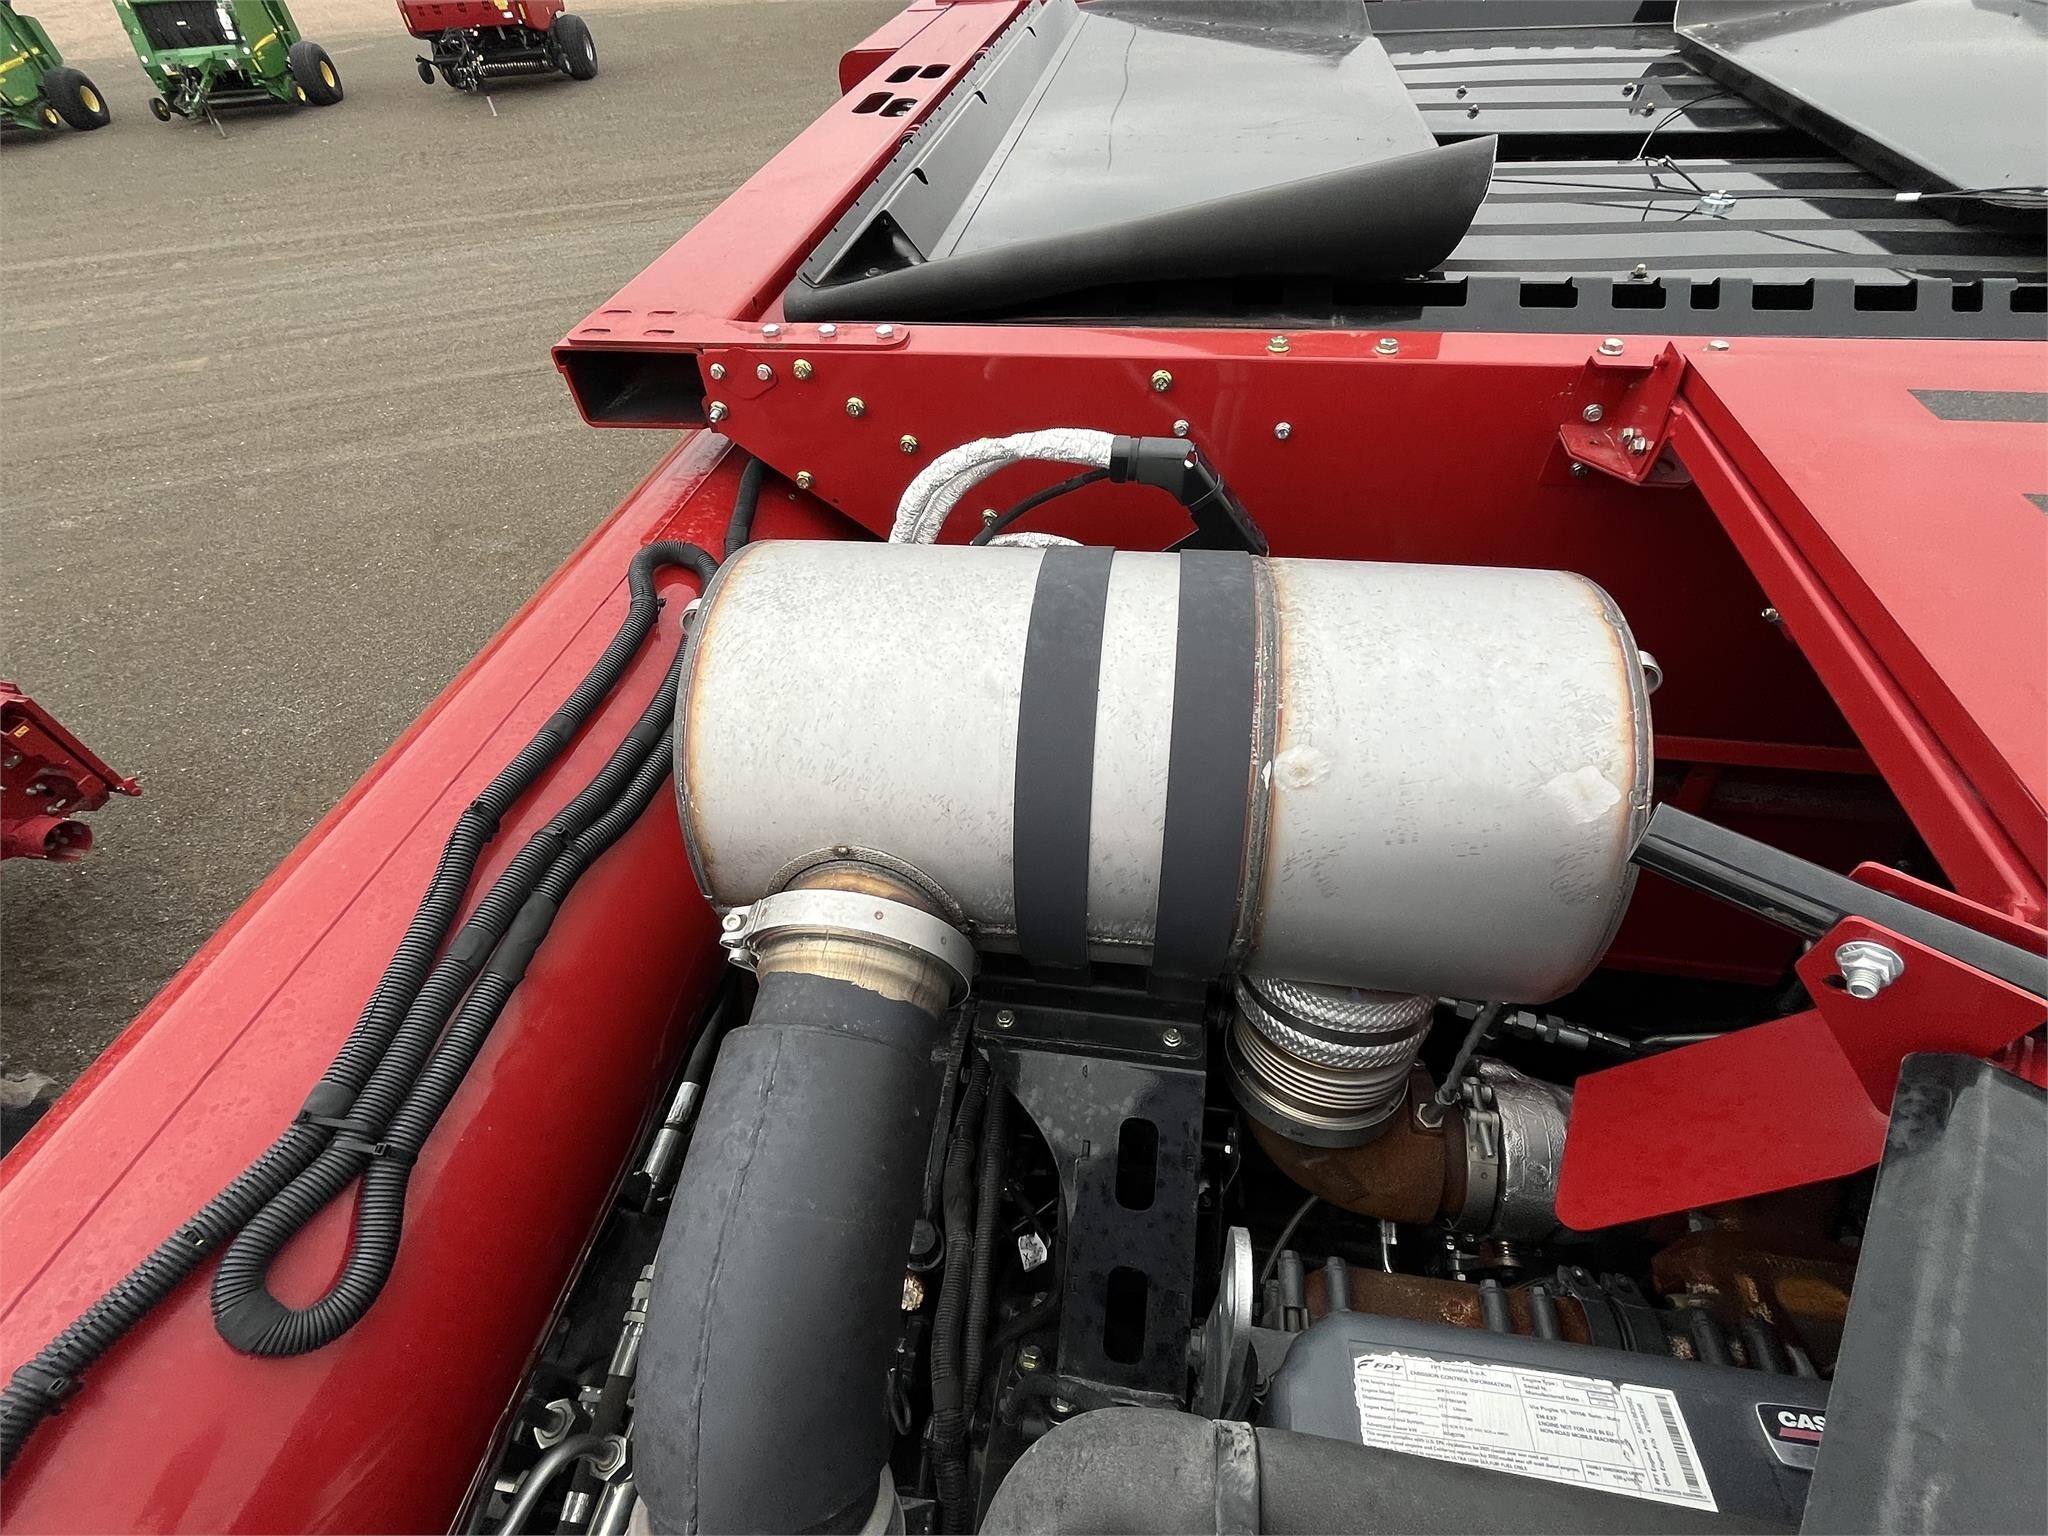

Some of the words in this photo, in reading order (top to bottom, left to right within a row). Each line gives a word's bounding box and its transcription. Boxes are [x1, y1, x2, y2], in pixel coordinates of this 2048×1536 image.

[1374, 1362, 1404, 1371] FPT
[1410, 1370, 1440, 1379] EMISSION
[1440, 1374, 1469, 1384] CONTROL
[1469, 1377, 1512, 1389] INFORMATION
[1522, 1375, 1542, 1384] Engine
[1525, 1389, 1566, 1400] Manufactured
[1777, 1410, 1826, 1433] CAS
[1538, 1420, 1559, 1429] ENGINE
[1560, 1423, 1572, 1431] NOT
[1585, 1427, 1597, 1435] USE
[1571, 1432, 1593, 1440] MOBILE
